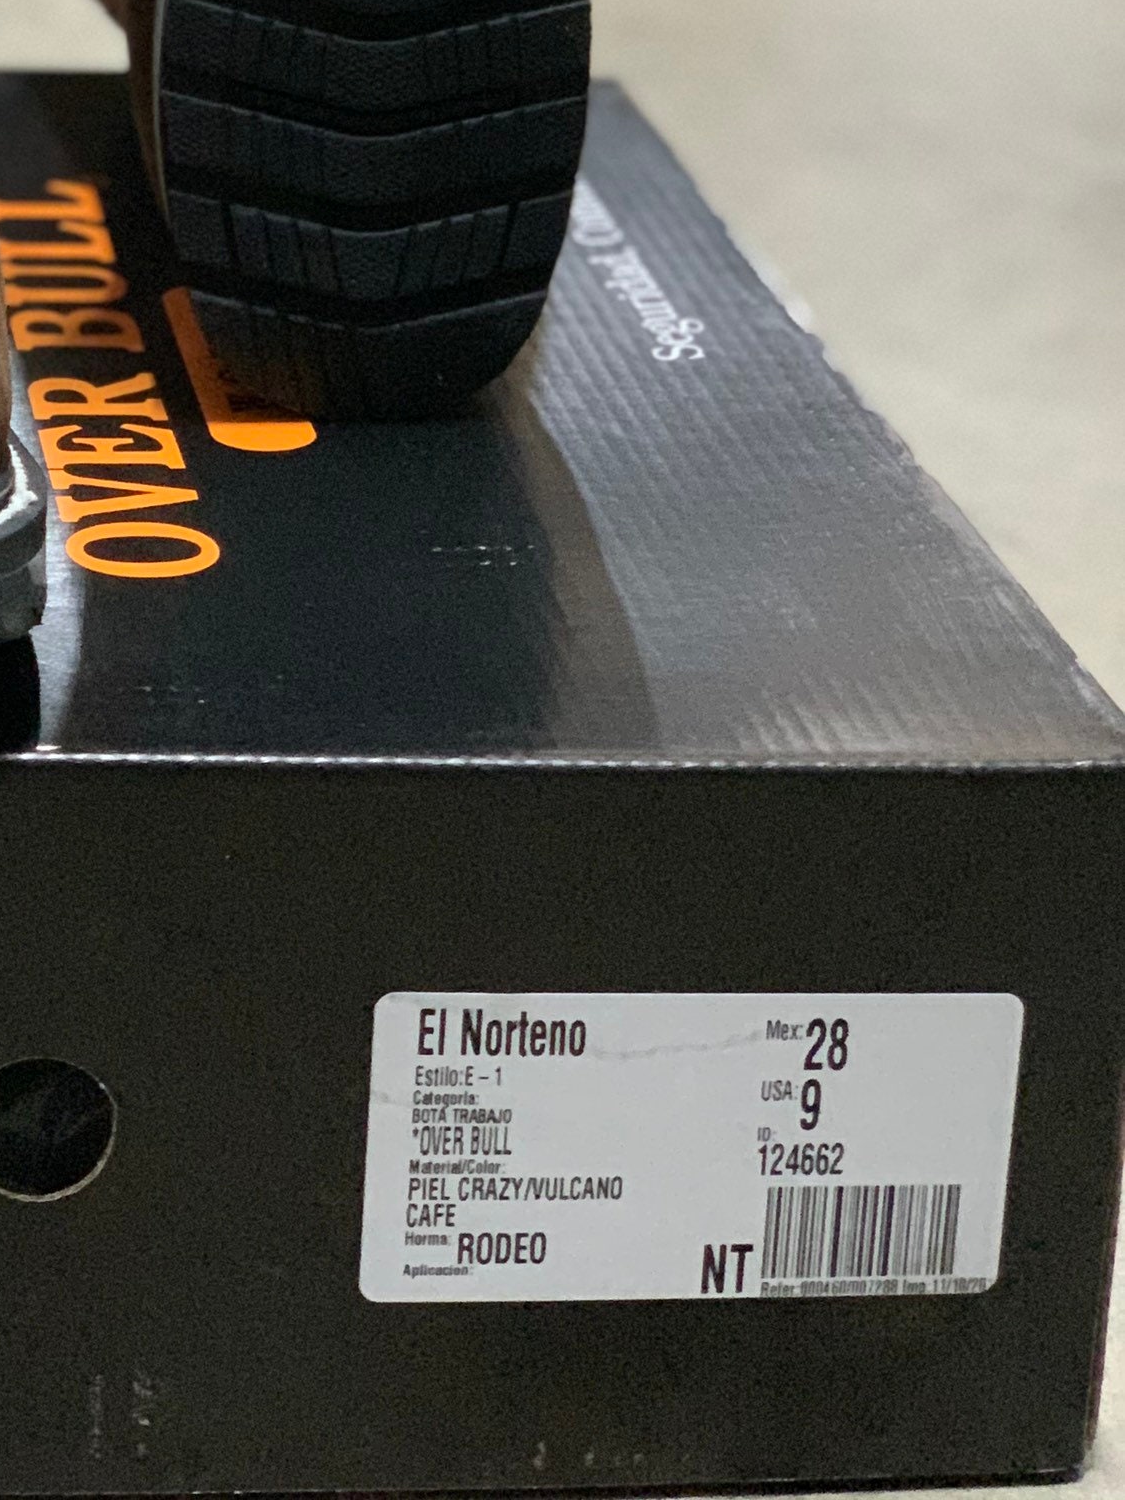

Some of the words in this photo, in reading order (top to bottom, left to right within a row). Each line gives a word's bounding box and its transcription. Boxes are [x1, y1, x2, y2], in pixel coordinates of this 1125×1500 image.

[27, 372, 220, 579] OVER
[418, 1008, 447, 1056] El
[461, 1008, 587, 1057] Norteno
[803, 1018, 850, 1071] 28
[453, 1108, 513, 1124] TRABAJO
[800, 1079, 822, 1130] 9
[470, 1125, 512, 1155] BULL
[758, 1142, 845, 1176] 124662
[408, 1177, 451, 1201] PIEL
[406, 1203, 457, 1227] CAFE
[457, 1232, 547, 1265] RODEO
[701, 1244, 754, 1294] NT
